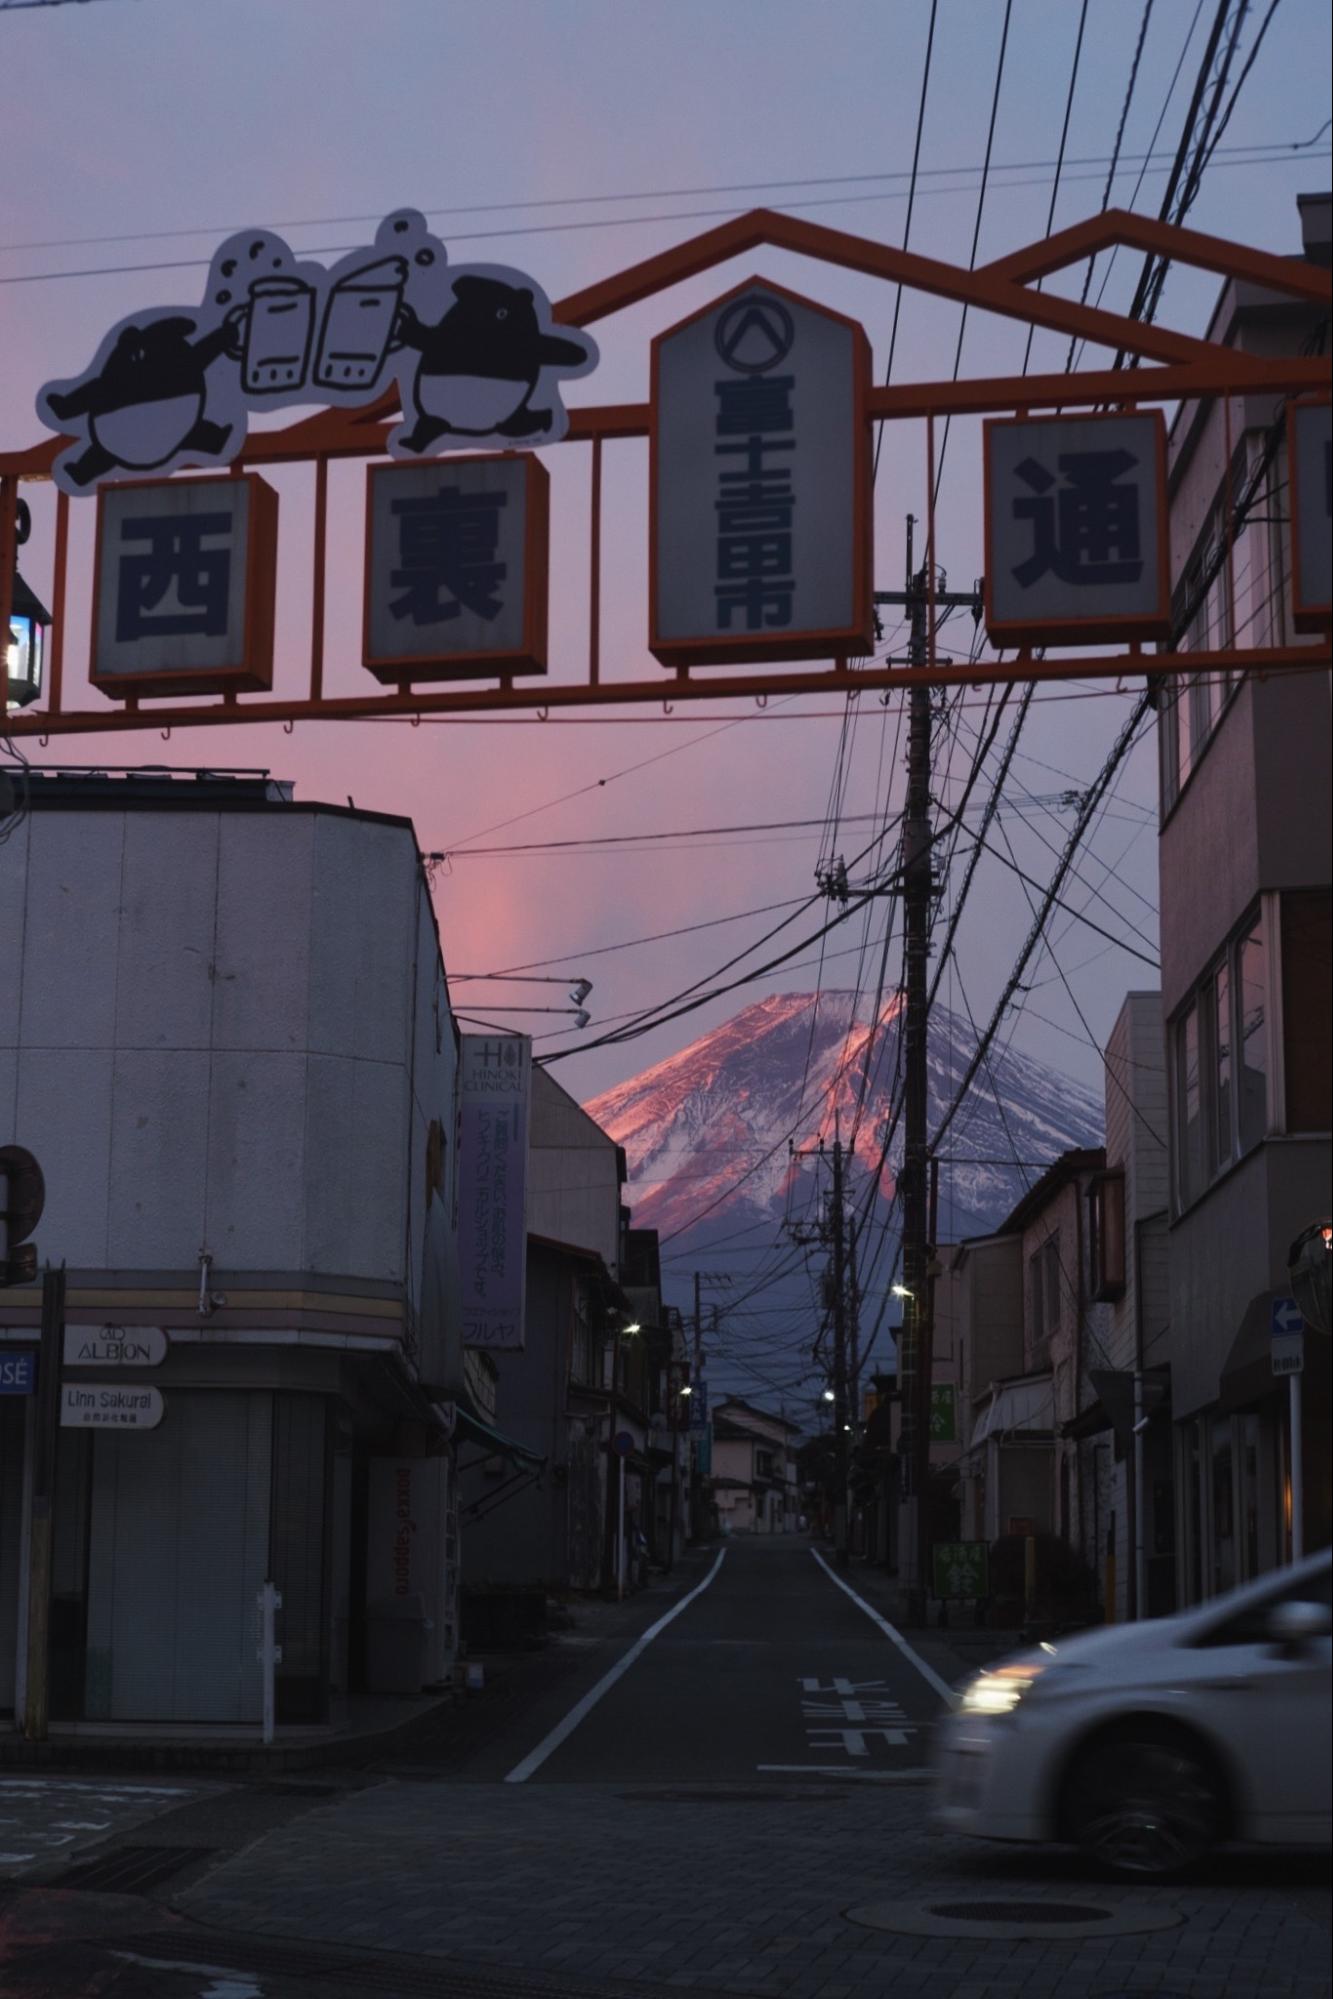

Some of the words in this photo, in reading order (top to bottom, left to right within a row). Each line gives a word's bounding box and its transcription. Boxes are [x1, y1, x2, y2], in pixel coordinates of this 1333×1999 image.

[714, 374, 796, 630] 富士吉田市
[115, 511, 232, 643] 西
[390, 485, 507, 625] 裏
[1010, 448, 1143, 588] 通
[472, 1069, 521, 1081] HINOKI
[463, 1080, 521, 1093] CLINICAL
[464, 1322, 515, 1341] フルヤ
[78, 1343, 150, 1360] ALBION
[0, 1358, 28, 1384] SÉ
[100, 1391, 152, 1409] Sakurai
